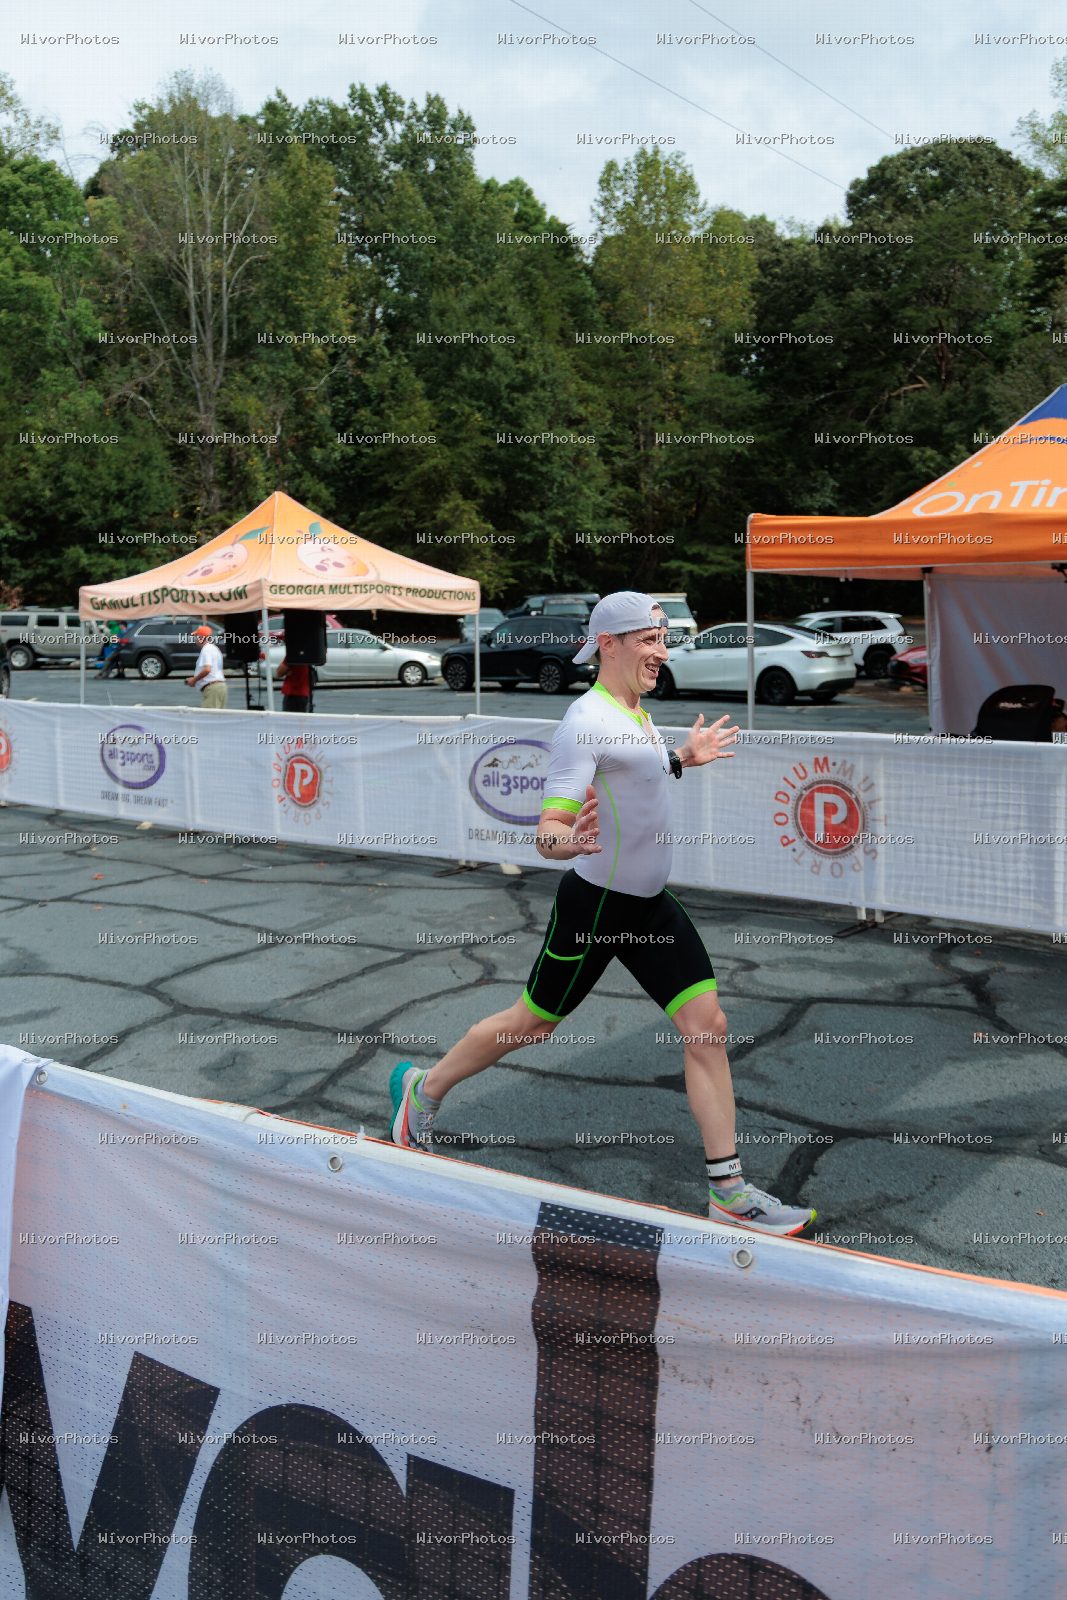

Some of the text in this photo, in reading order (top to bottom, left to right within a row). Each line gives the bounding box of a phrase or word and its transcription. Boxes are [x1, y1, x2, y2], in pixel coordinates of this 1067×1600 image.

[269, 583, 476, 601] GEORGIA MULTISPORTS PRODUCTIONS
[481, 771, 548, 796] all3spor
[773, 755, 831, 848] PODIUM
